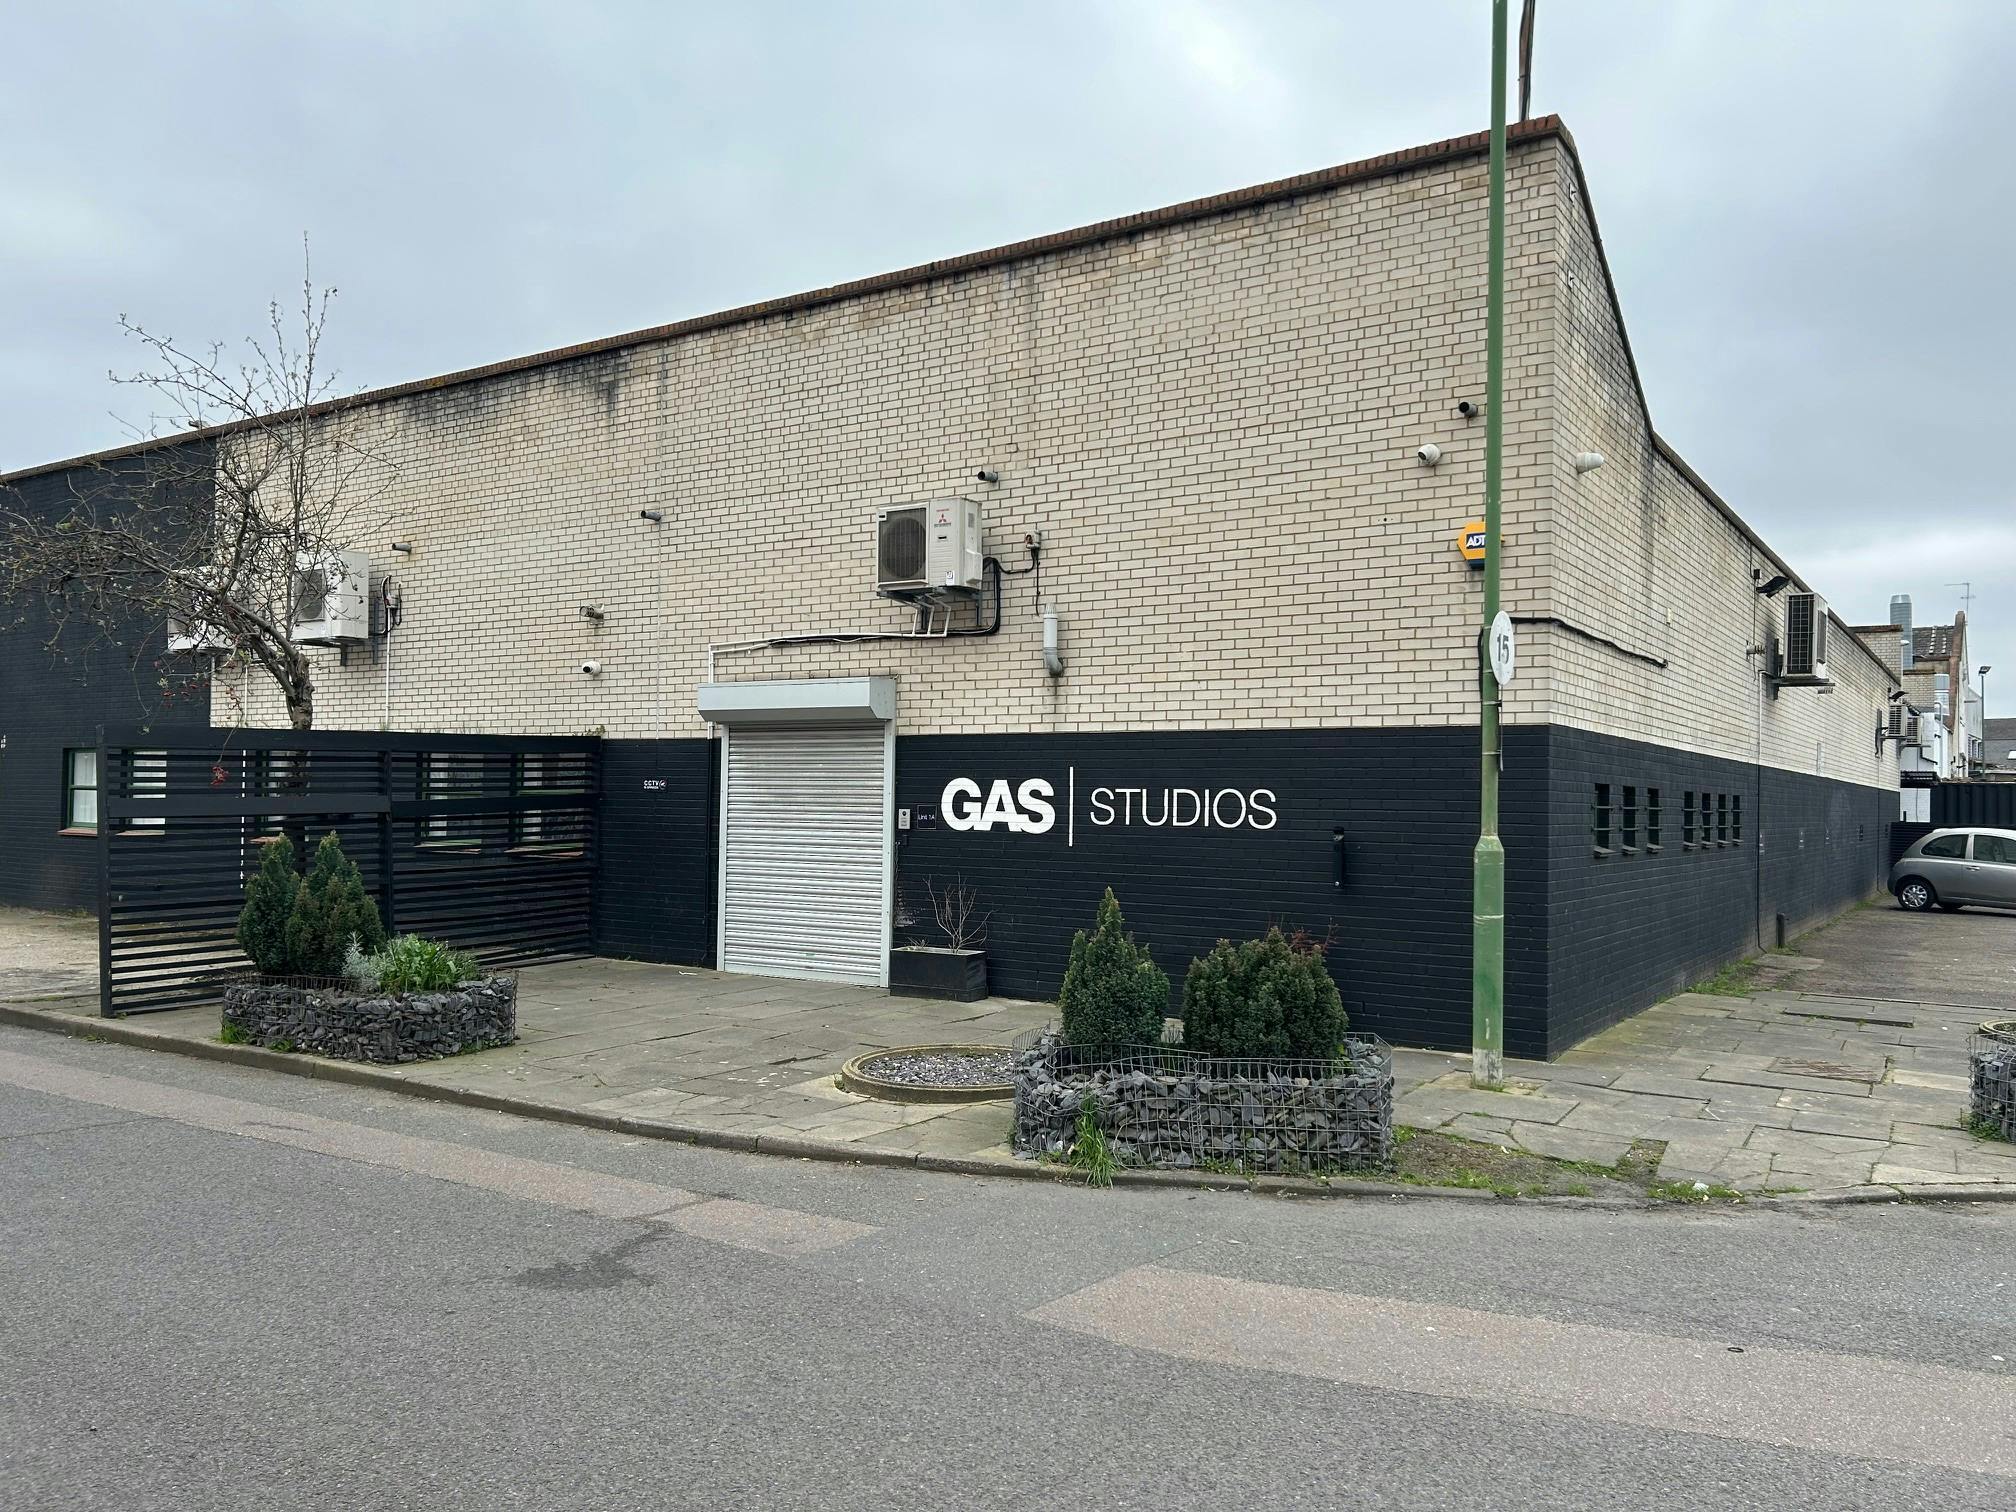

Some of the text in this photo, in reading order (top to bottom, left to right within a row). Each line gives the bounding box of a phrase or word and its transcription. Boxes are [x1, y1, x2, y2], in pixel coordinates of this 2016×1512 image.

[1466, 535, 1486, 547] ADT
[1496, 633, 1510, 665] 15
[941, 777, 1277, 834] GAS STUDIOS
